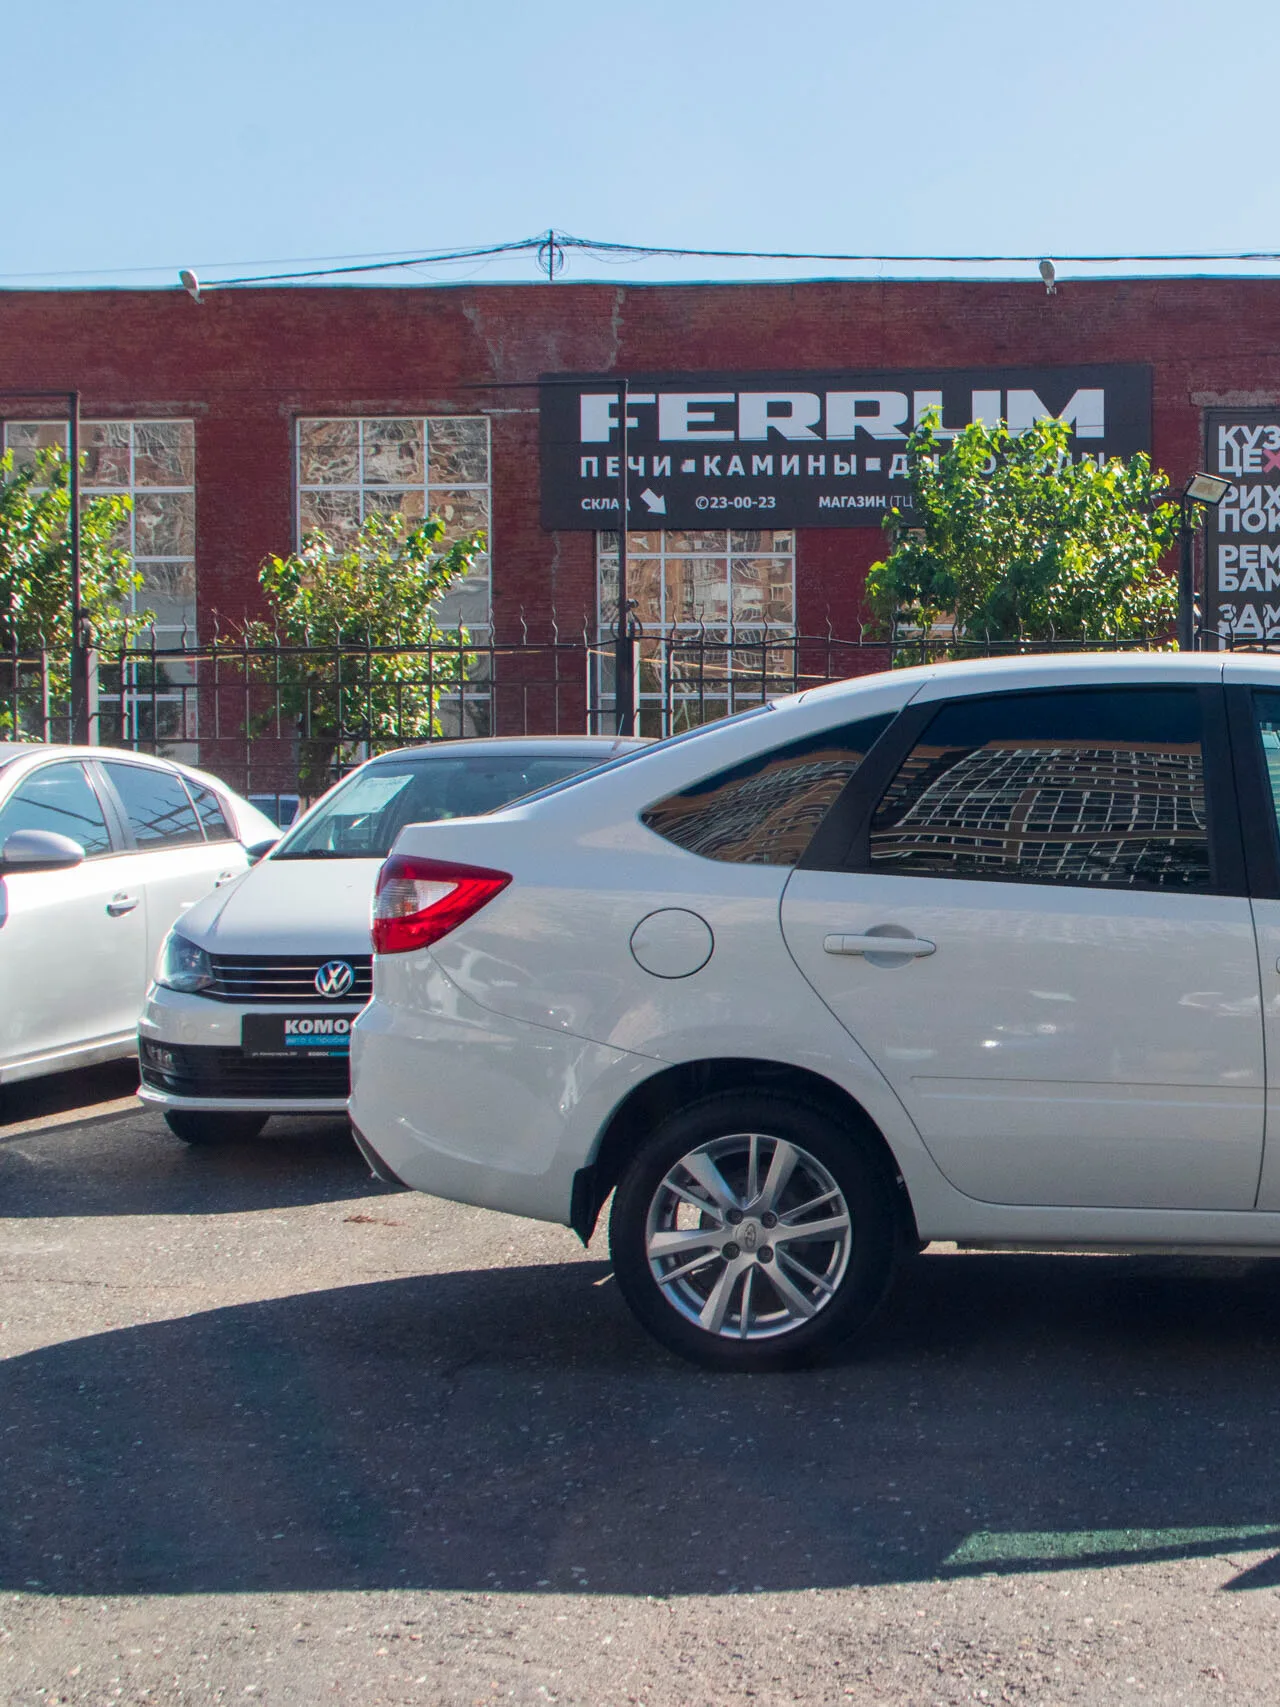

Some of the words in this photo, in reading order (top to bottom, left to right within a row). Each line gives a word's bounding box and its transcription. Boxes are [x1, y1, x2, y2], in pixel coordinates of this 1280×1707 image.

[580, 389, 1105, 442] FERRUM
[580, 456, 672, 478] ПЕЧИ
[703, 454, 857, 477] КАМИНЫ
[818, 495, 886, 509] МАГАЗИН
[285, 1019, 351, 1034] КОМО
